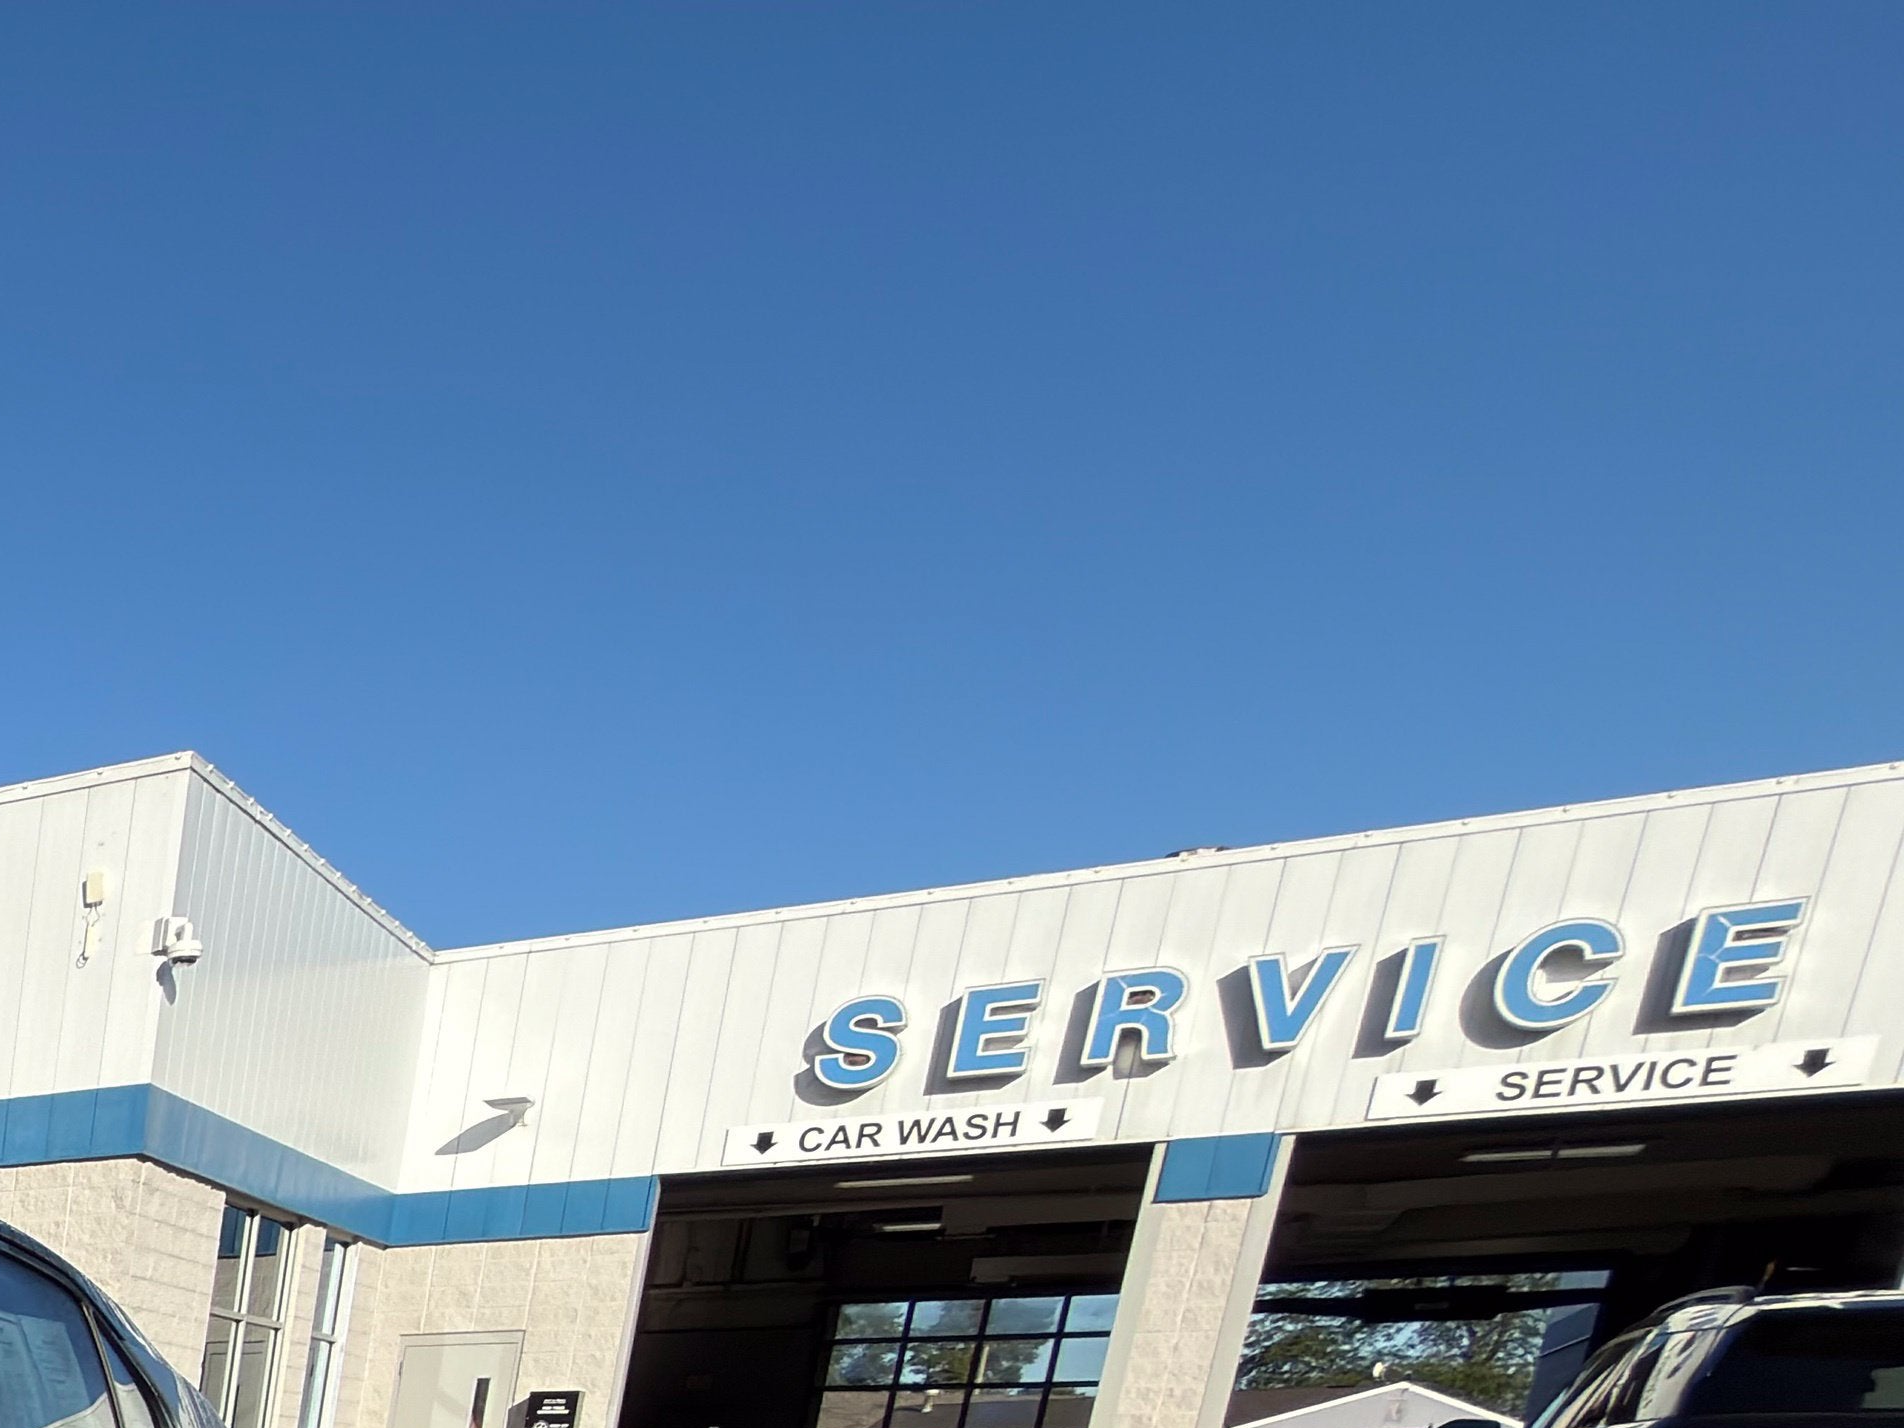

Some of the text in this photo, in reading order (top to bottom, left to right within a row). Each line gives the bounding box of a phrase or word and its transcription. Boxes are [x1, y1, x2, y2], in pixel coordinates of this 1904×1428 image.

[813, 896, 1811, 1091] SERVICE
[1495, 1054, 1738, 1101] SERVICE
[798, 1111, 1022, 1152] CAR WASH
